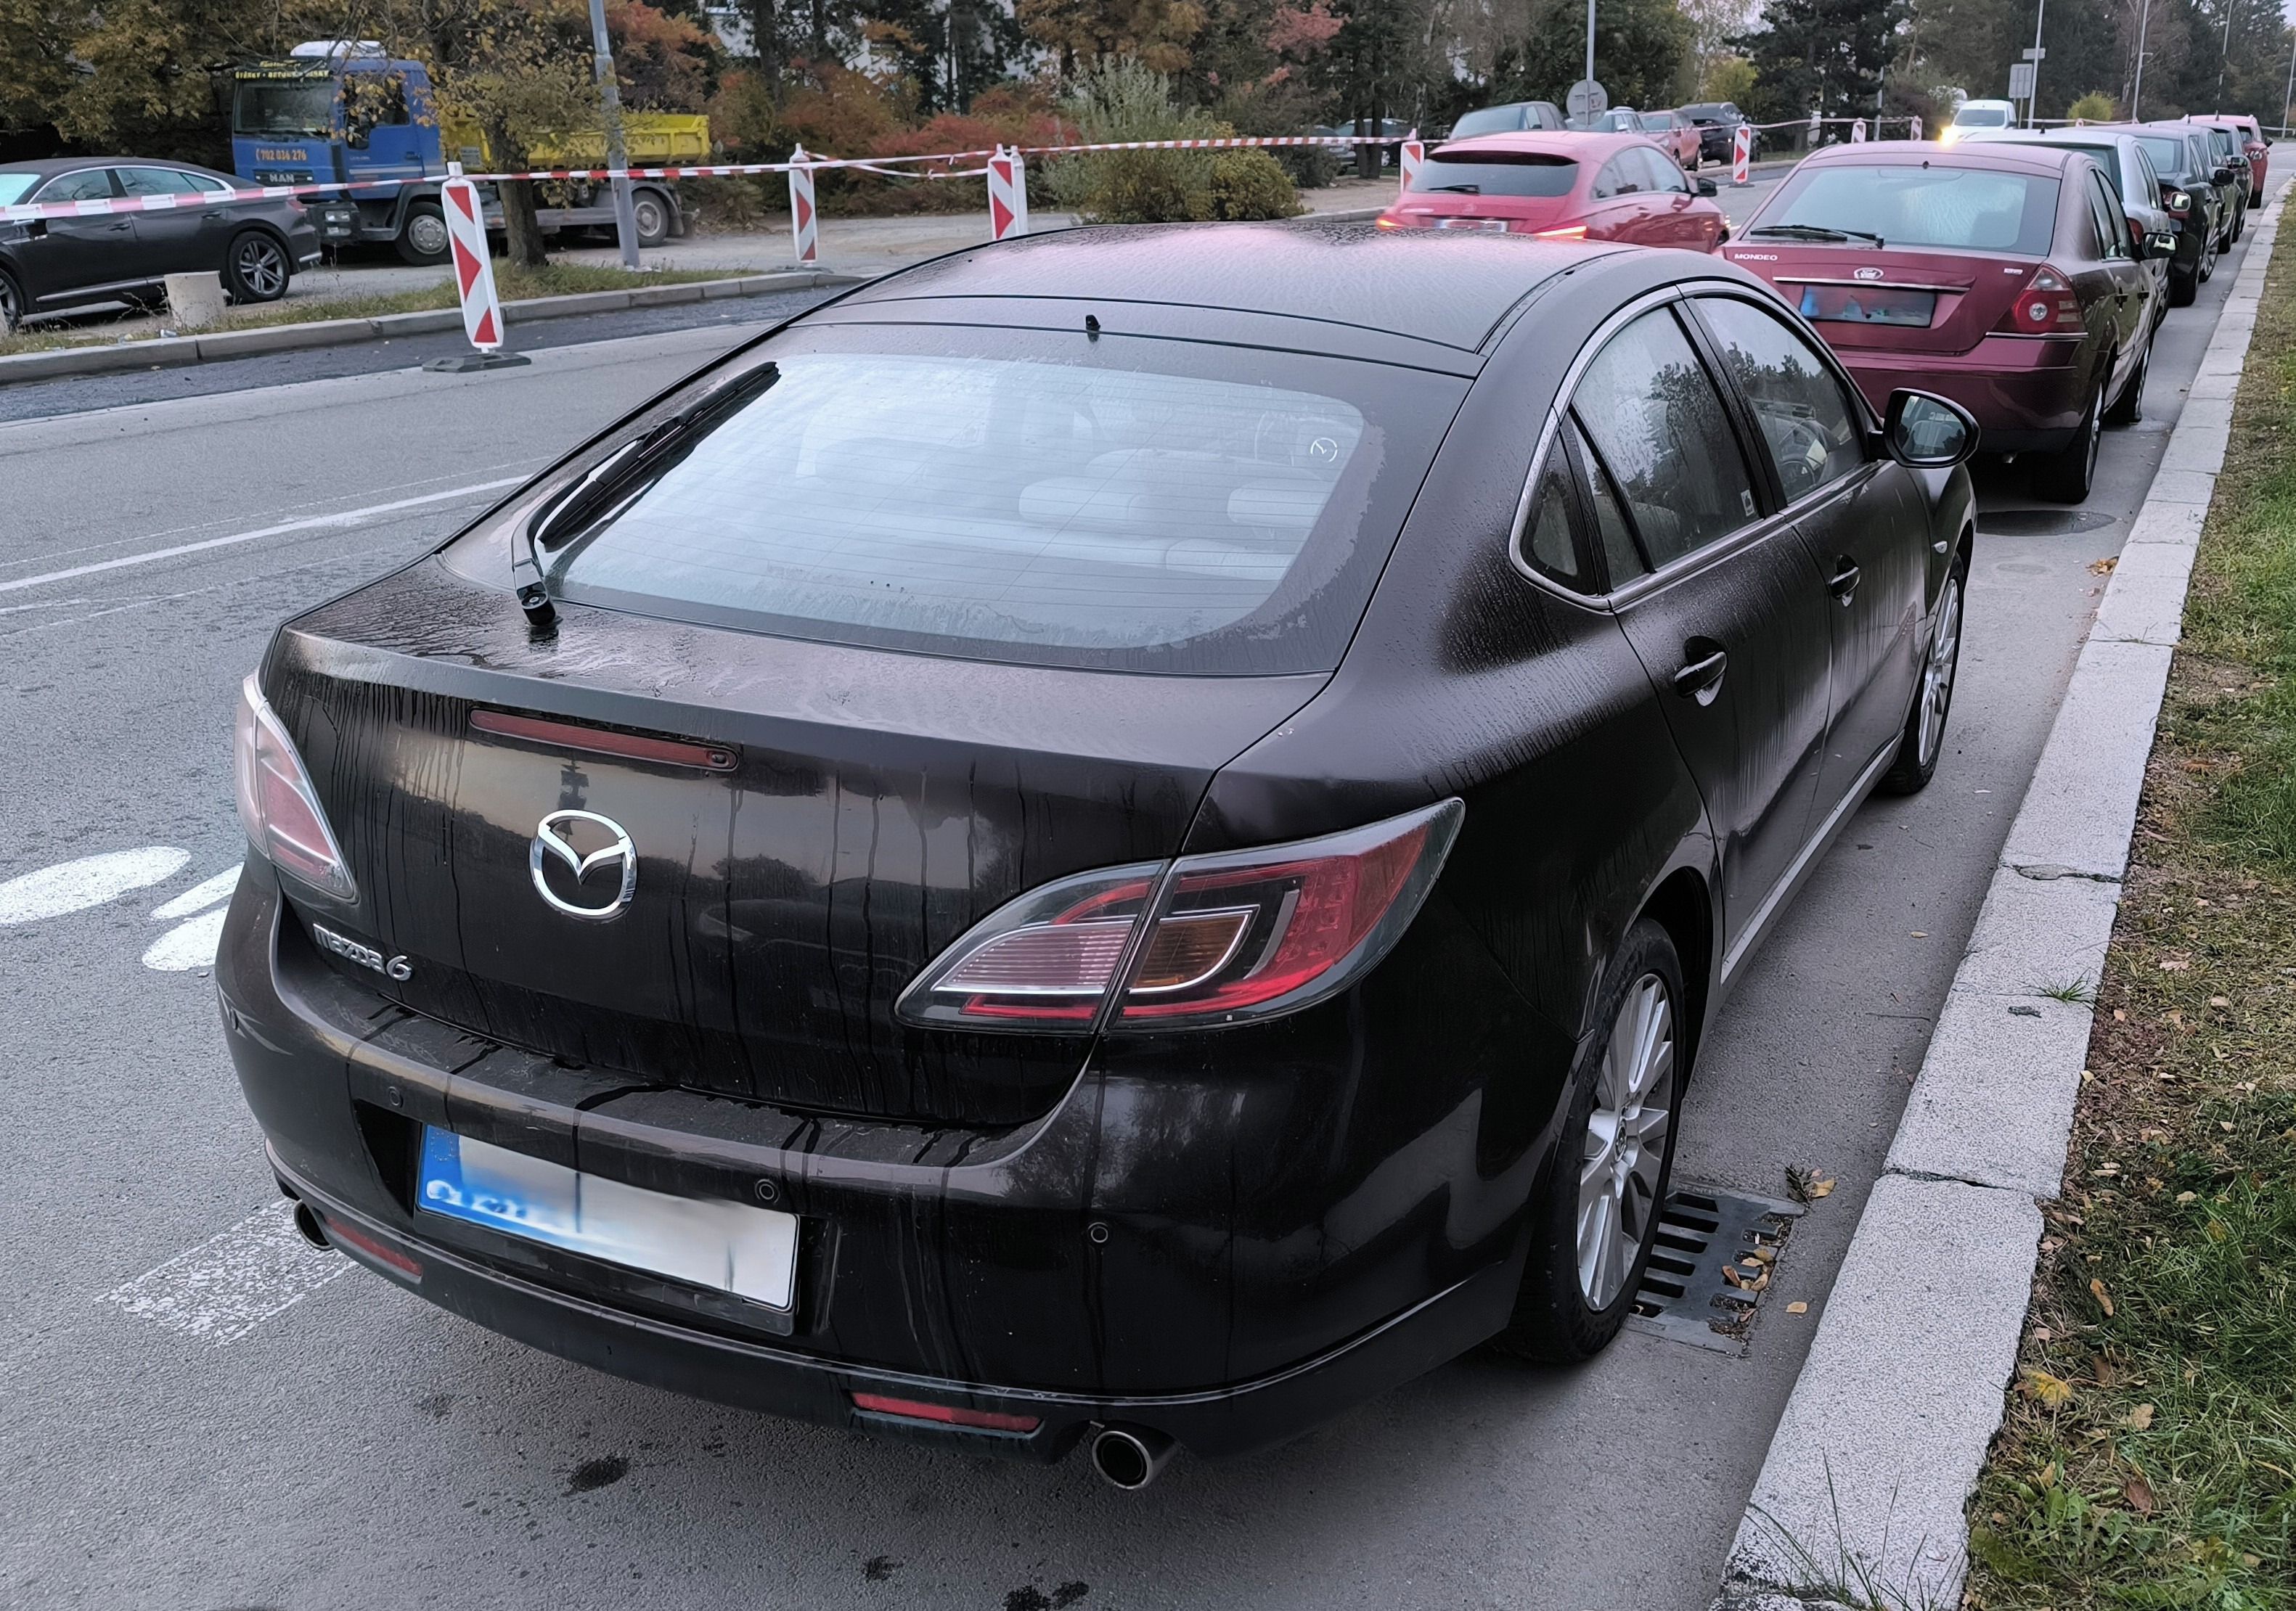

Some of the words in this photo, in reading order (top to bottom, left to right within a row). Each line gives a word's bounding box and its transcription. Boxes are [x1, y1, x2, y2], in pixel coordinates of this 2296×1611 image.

[261, 149, 274, 160] 702
[292, 149, 307, 160] 276
[269, 173, 295, 183] MAN
